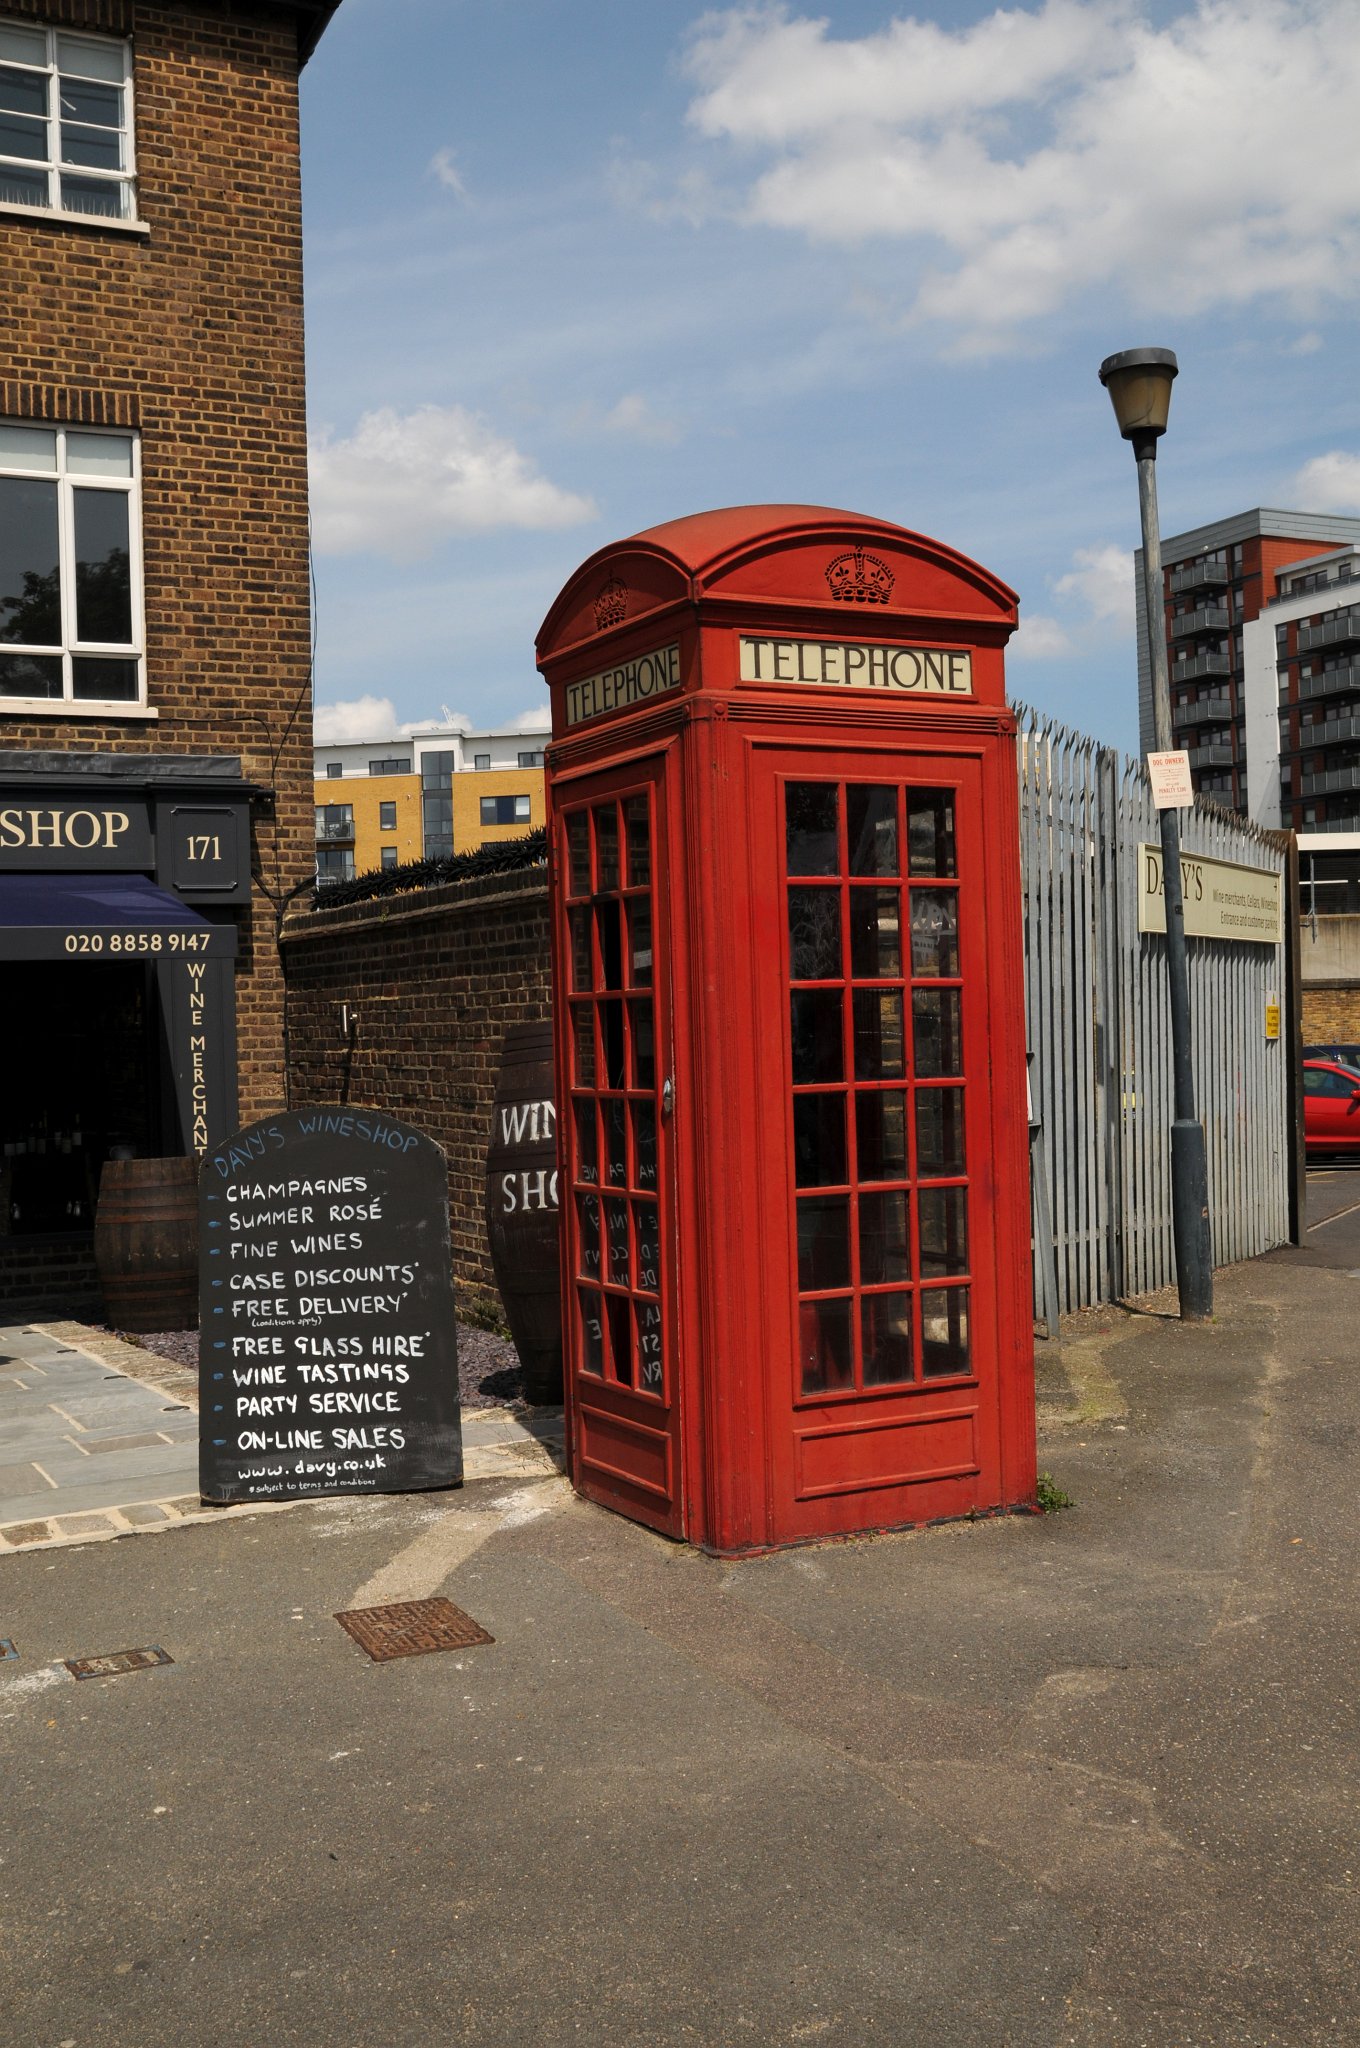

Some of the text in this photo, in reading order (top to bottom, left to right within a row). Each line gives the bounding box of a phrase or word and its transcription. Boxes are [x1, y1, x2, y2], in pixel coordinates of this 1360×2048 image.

[744, 638, 969, 692] TELEPHONE
[569, 645, 680, 724] TELEPHONE
[0, 809, 129, 848] SHOP
[186, 836, 222, 860] 171
[1146, 855, 1203, 901] DY'S
[65, 933, 211, 952] 020 8858 9147
[187, 963, 206, 1026] WINE
[190, 1035, 208, 1156] MERCHANT
[214, 1116, 418, 1178] DAVY'S WINESHOP
[226, 1176, 367, 1202] CHAMPAGNES
[229, 1197, 382, 1231] SUMMER ROSÉ
[230, 1232, 363, 1259] FINE WINES
[230, 1272, 286, 1290] CASE
[231, 1298, 289, 1318] FREE
[232, 1337, 285, 1357] FREE
[294, 1337, 363, 1357] GLASS
[232, 1363, 410, 1387] WINE TASTINGS
[236, 1391, 402, 1418] PARTY SERVICE
[237, 1427, 406, 1451] ON-LINE SALES
[287, 1482, 297, 1490] to
[299, 1481, 322, 1490] terms
[324, 1479, 338, 1488] and
[340, 1478, 376, 1487] conditions
